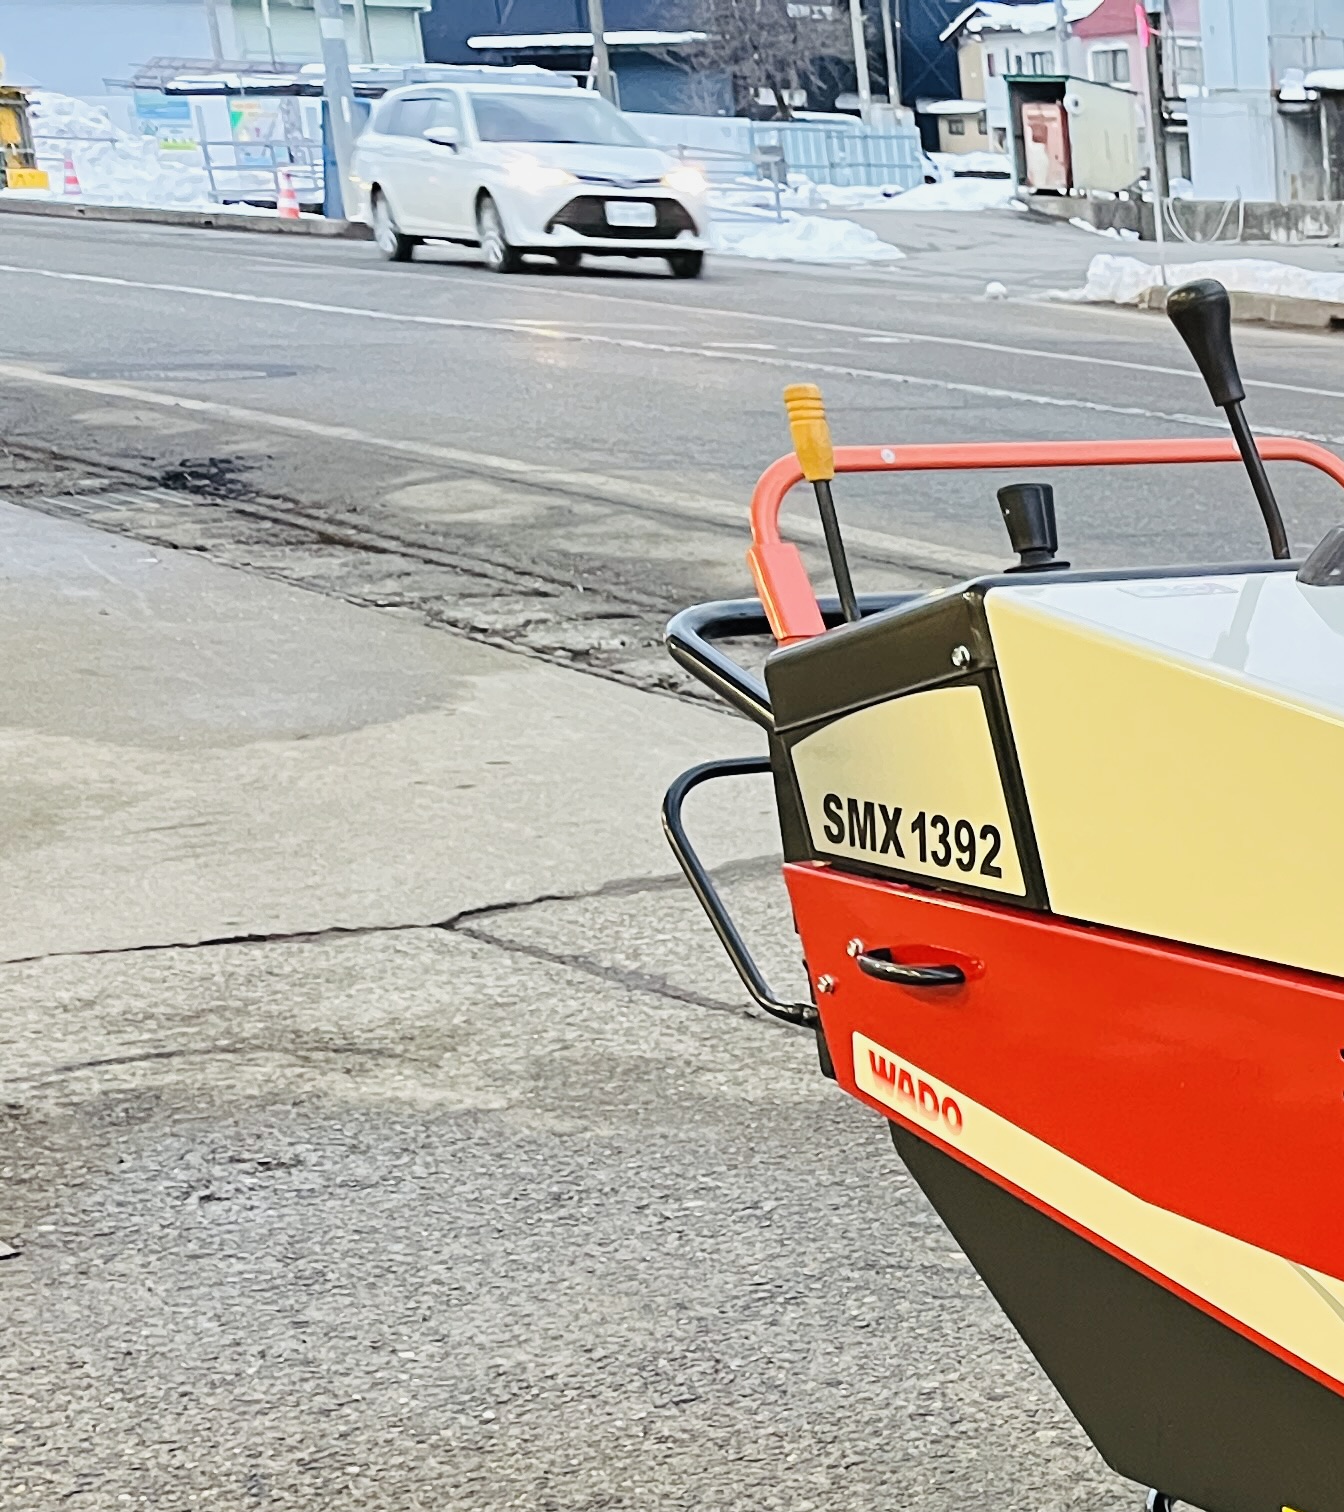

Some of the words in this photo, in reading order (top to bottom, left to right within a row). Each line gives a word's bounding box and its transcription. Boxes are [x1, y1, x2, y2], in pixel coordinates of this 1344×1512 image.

[823, 793, 905, 859] SMX
[911, 811, 1002, 879] 1392
[868, 1049, 963, 1136] WADO
